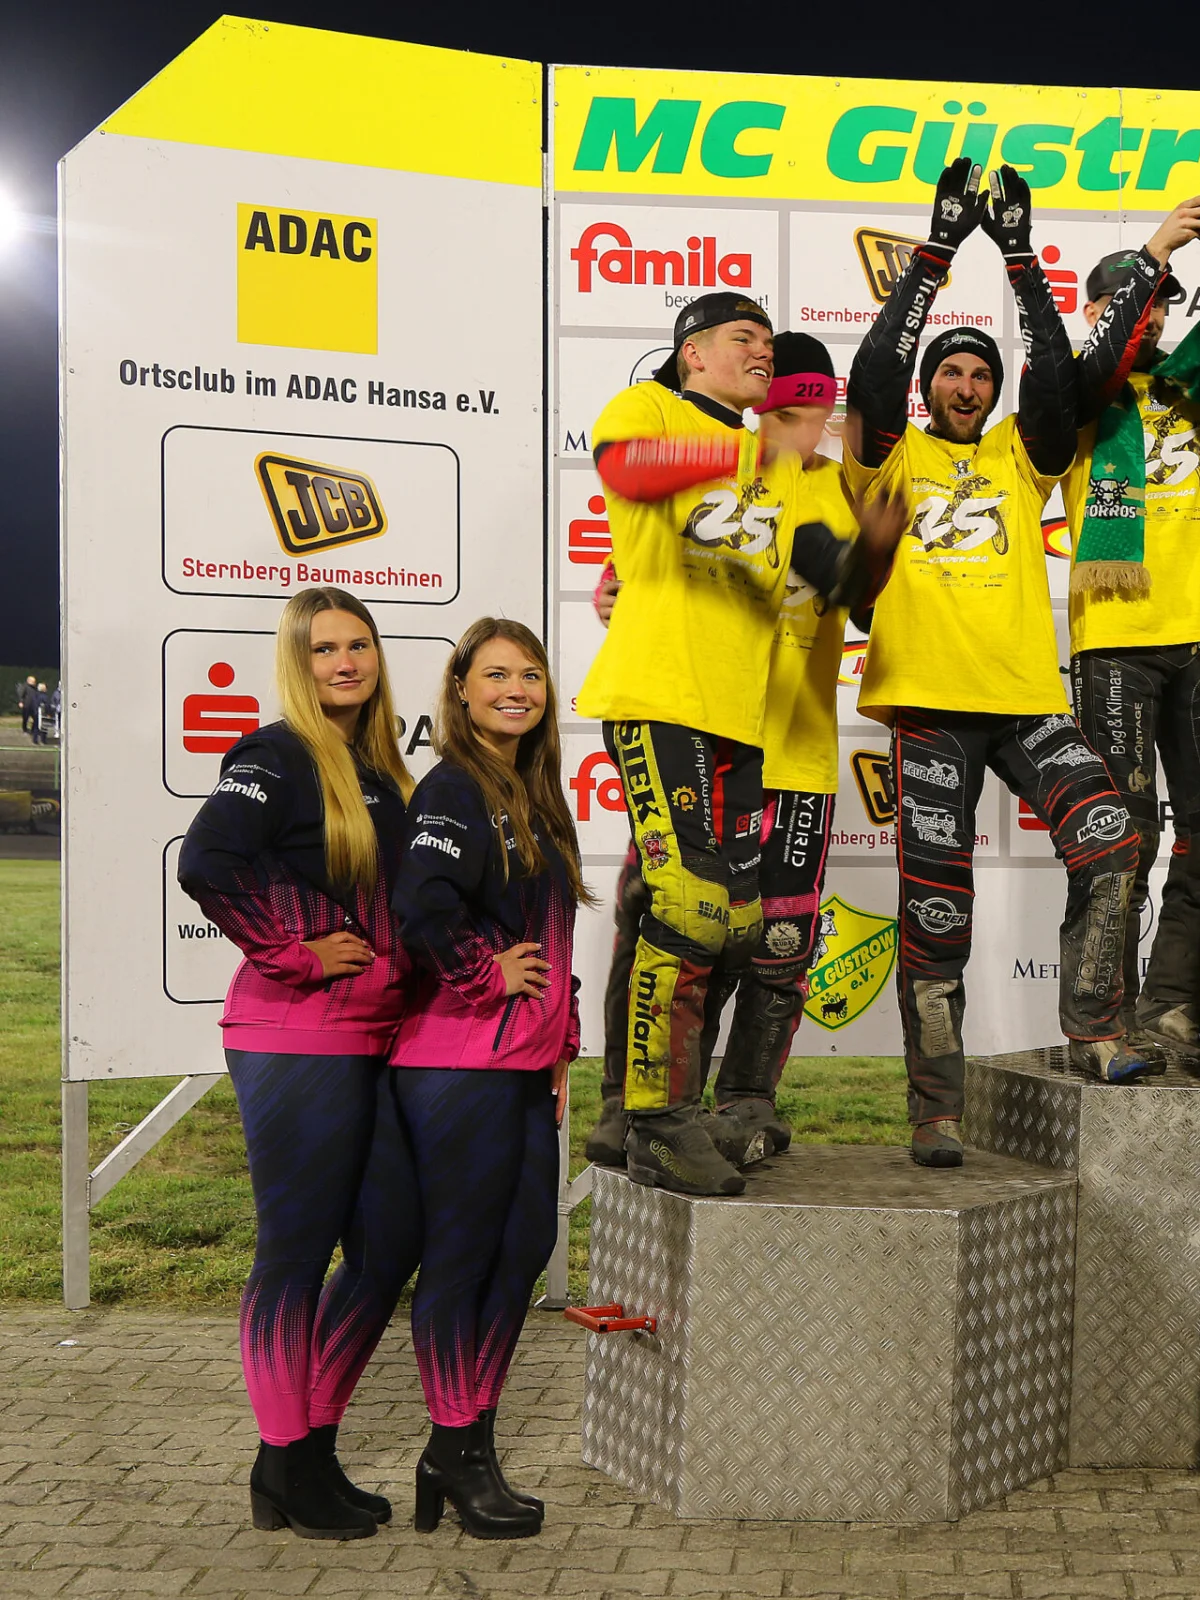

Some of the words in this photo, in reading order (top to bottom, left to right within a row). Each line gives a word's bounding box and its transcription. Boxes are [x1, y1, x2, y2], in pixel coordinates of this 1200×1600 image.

[573, 96, 786, 178] MC
[244, 211, 373, 263] ADAC
[570, 221, 752, 292] famila
[119, 359, 235, 394] Ortsclub
[246, 369, 277, 397] im
[286, 373, 357, 403] ADAC
[368, 380, 447, 411] Hansa
[456, 389, 500, 415] e.V.
[795, 382, 824, 398] 212
[285, 470, 371, 540] JCB
[695, 489, 782, 555] 25
[916, 496, 1006, 550] 25
[182, 557, 291, 587] Sternberg
[297, 562, 443, 588] Baumaschinen
[1106, 676, 1123, 716] Klima
[410, 831, 461, 859] famila
[824, 928, 895, 984] GÜSTROW
[850, 966, 875, 991] e.V.
